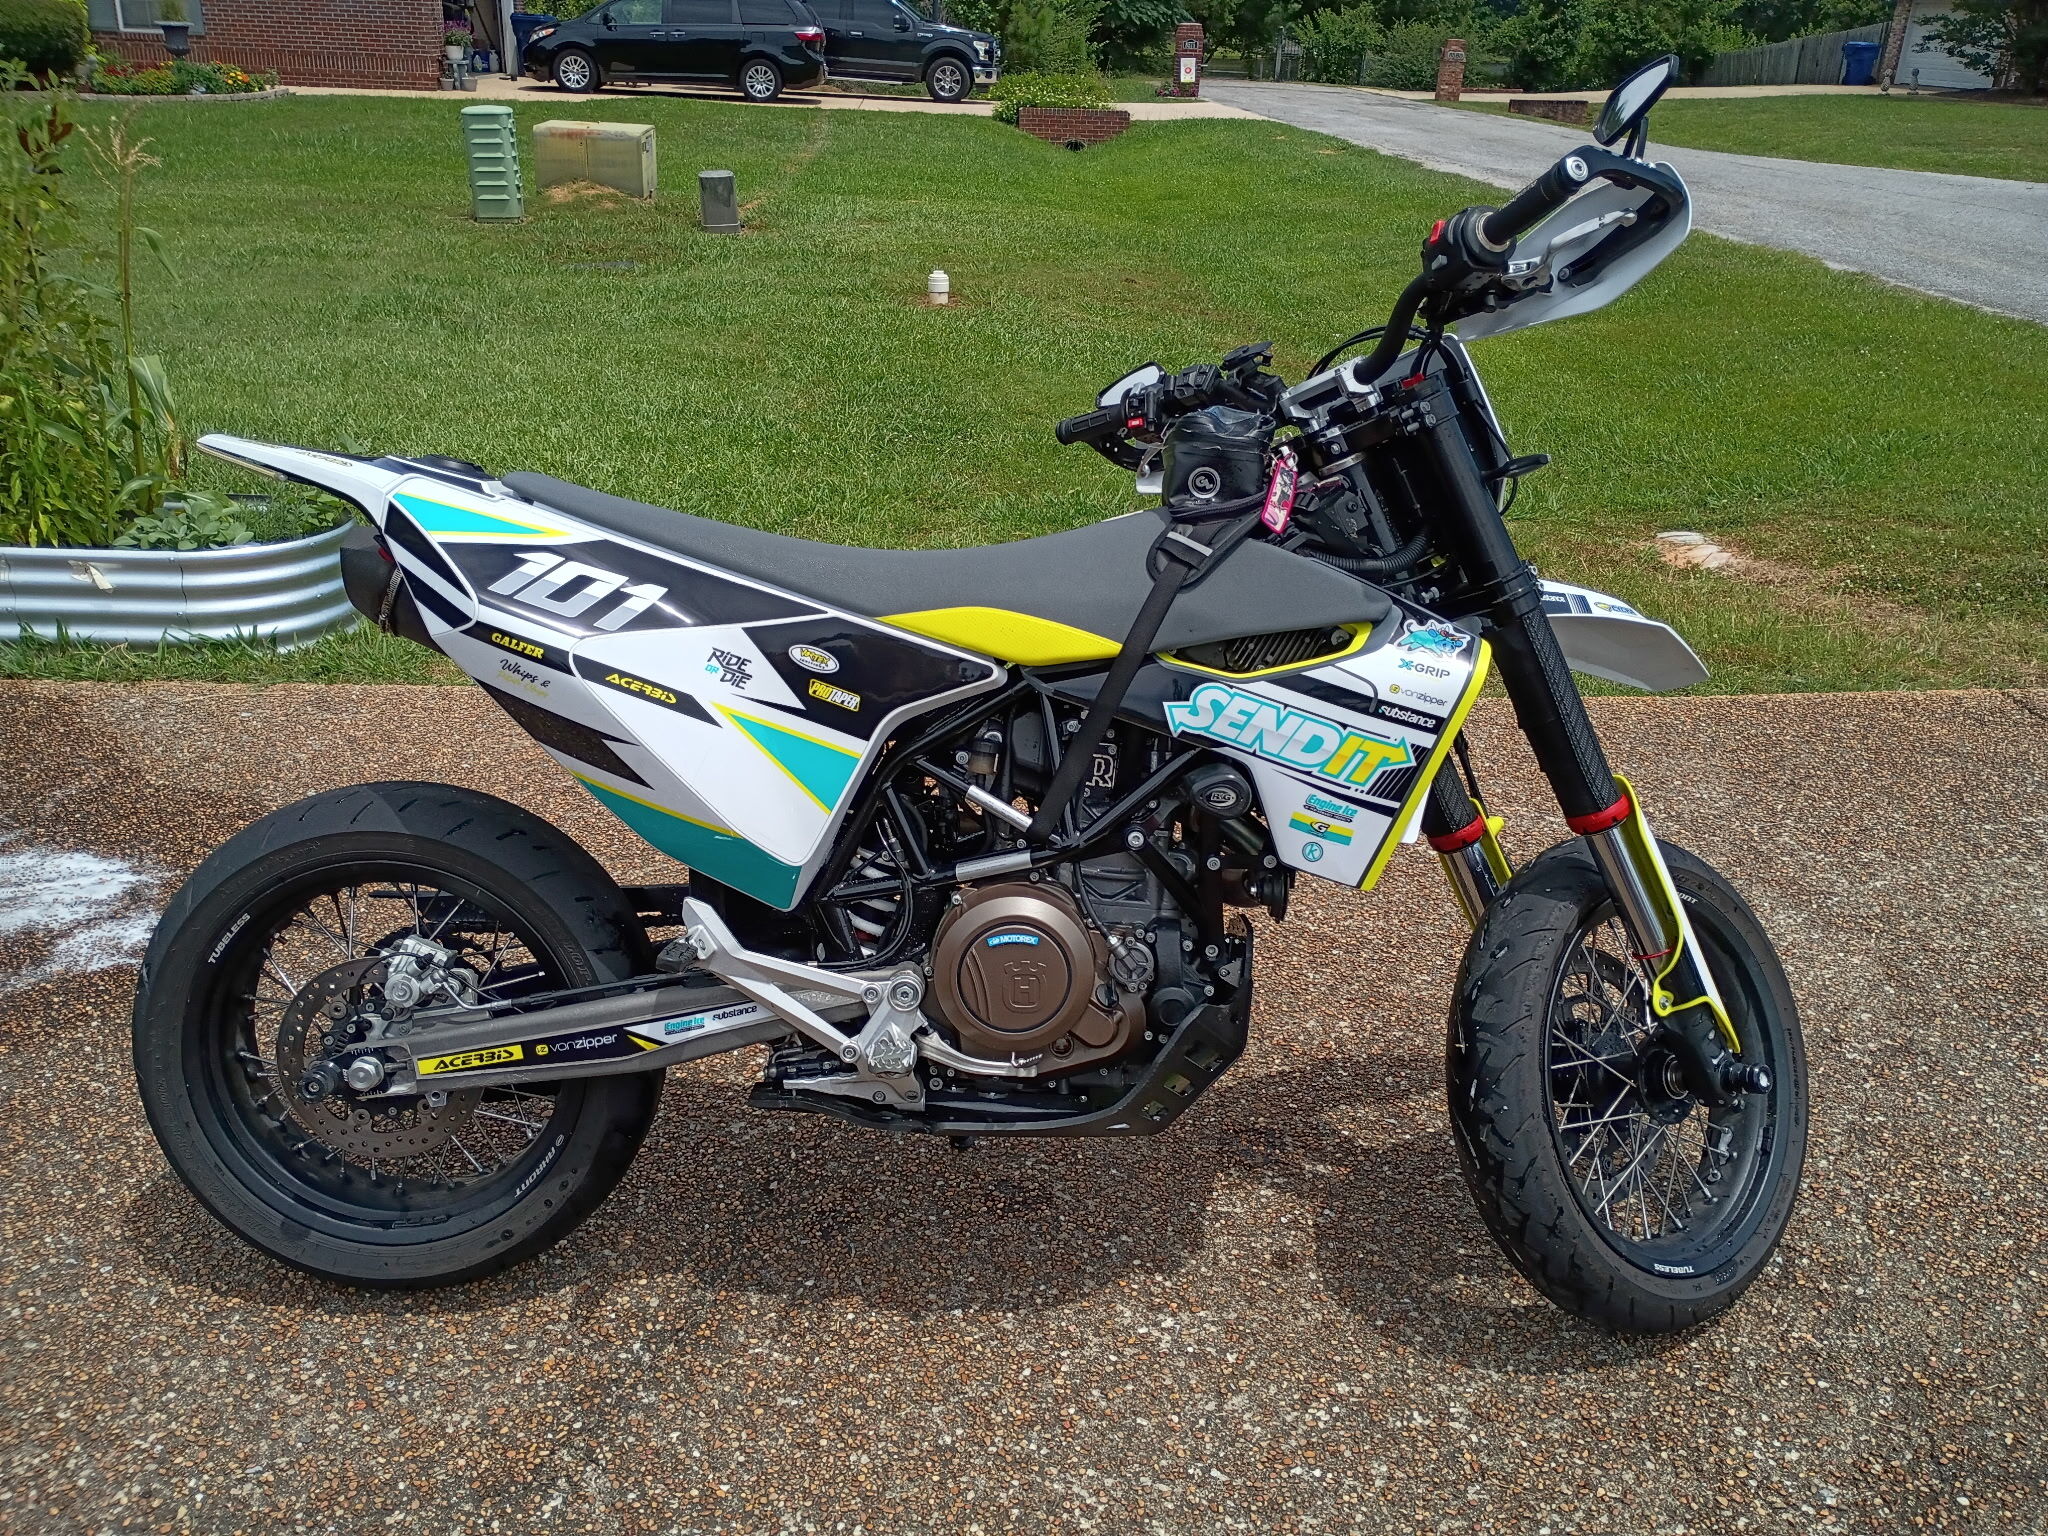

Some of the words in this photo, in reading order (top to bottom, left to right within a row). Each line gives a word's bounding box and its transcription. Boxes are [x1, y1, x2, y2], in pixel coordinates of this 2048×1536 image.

[488, 552, 669, 631] 101
[491, 632, 544, 659] GALFER
[500, 659, 538, 683] Whips
[540, 680, 550, 688] &
[704, 664, 719, 674] OR
[605, 673, 677, 704] ACERBIS
[1400, 688, 1448, 707] vonzipper
[1379, 705, 1436, 728] substance
[1306, 793, 1343, 812] Engine
[207, 912, 251, 964] TUBELESS
[1000, 934, 1038, 945] MOTOREX
[712, 1005, 757, 1021] substance
[665, 1020, 693, 1031] Engine
[550, 1034, 617, 1052] vonzipper
[434, 1048, 514, 1071] ACERBIS
[1654, 1263, 1695, 1274] TUBELESS
